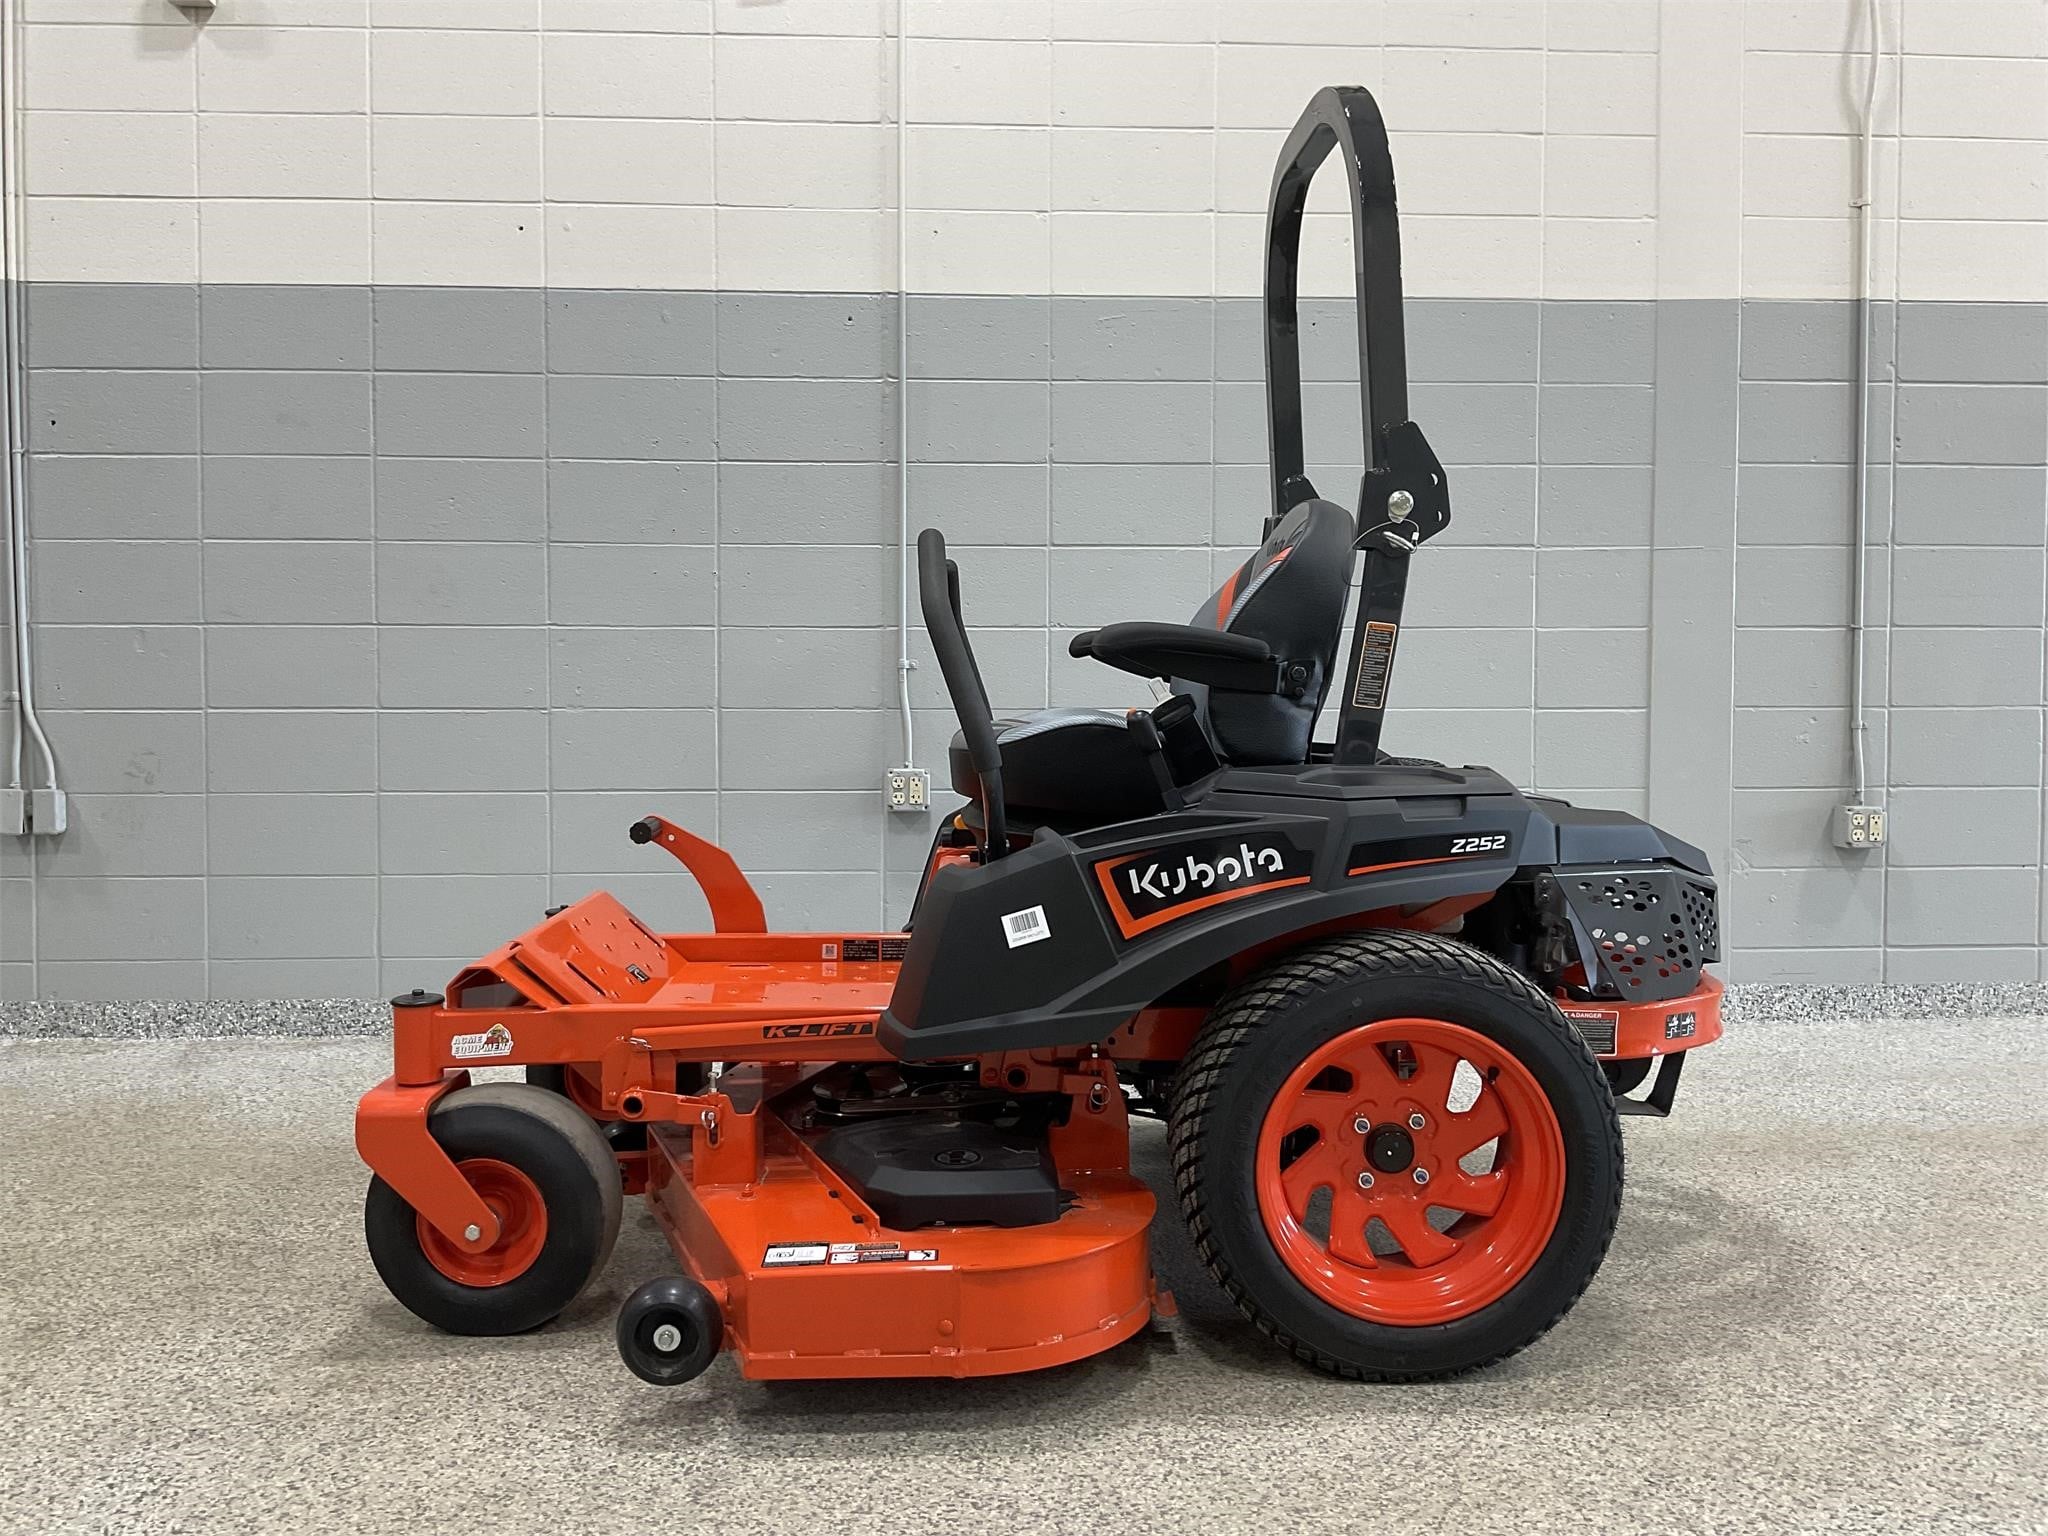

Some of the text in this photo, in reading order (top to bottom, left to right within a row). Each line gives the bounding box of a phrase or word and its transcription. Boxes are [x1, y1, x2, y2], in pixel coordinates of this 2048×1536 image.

[1450, 835, 1506, 854] Z252
[1128, 843, 1284, 899] Kubota
[766, 1022, 871, 1038] K-LIFT
[453, 1035, 483, 1045] ACME
[453, 1042, 513, 1055] EQUIPMENT
